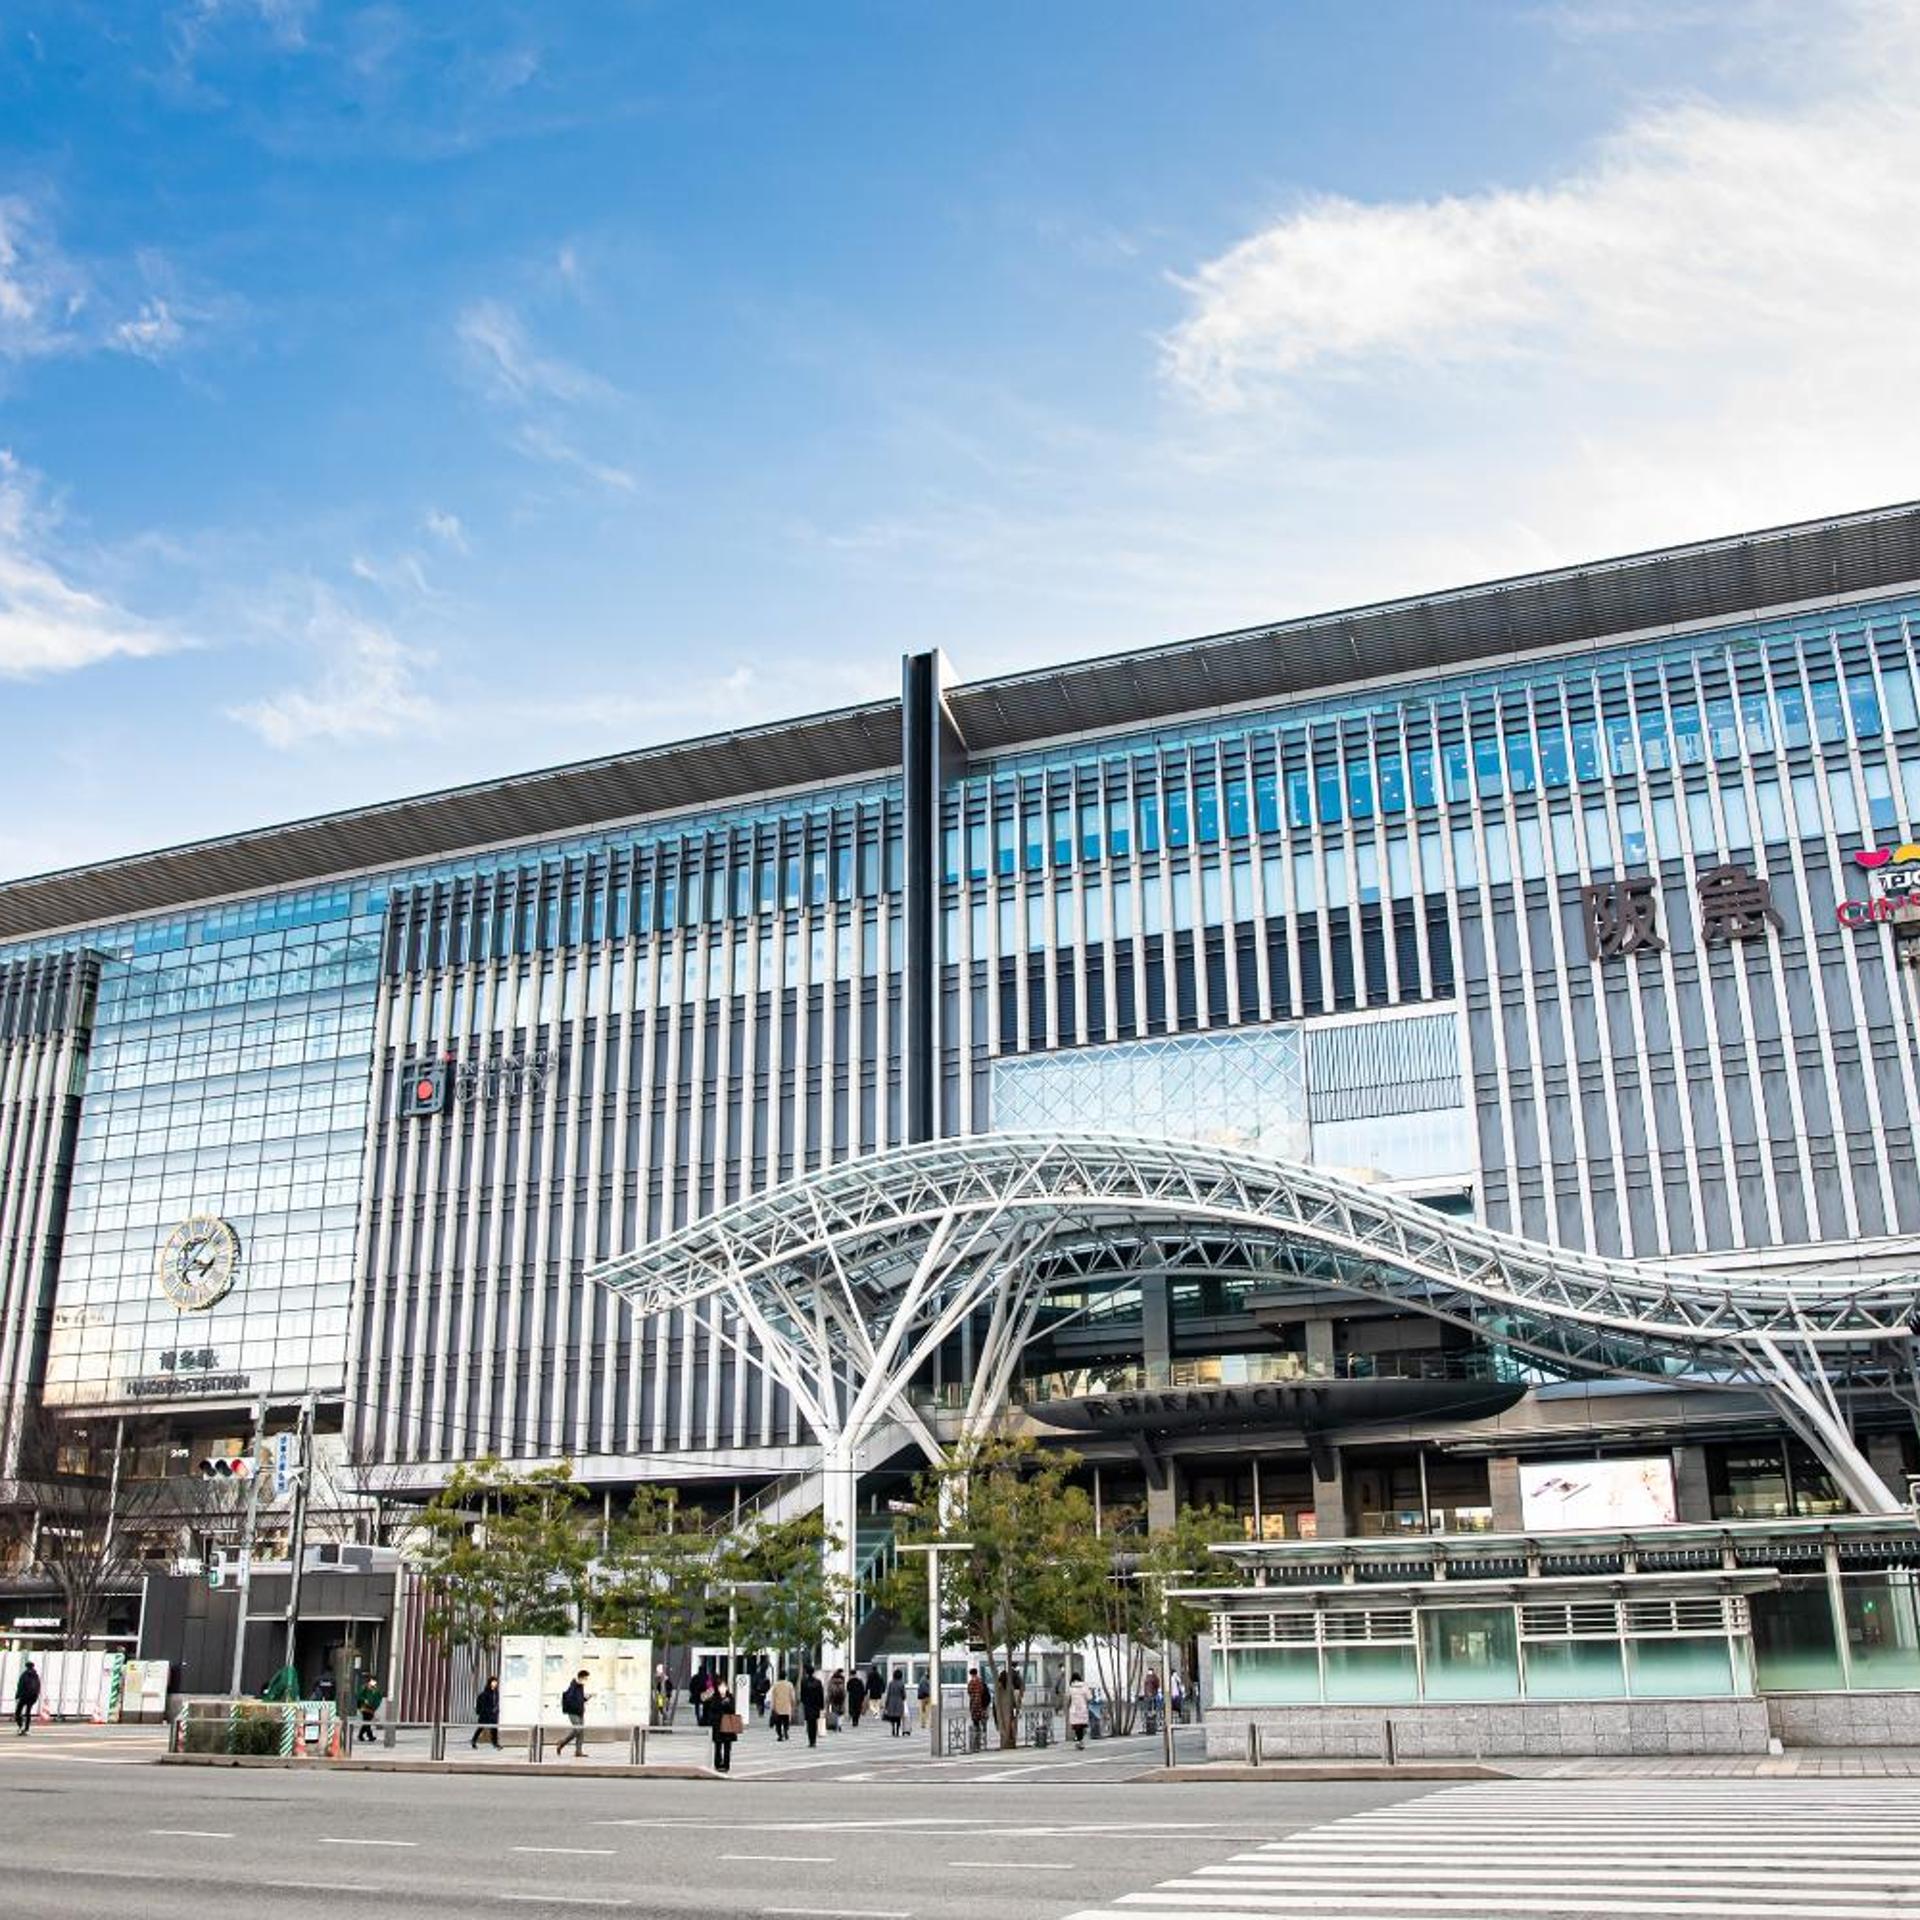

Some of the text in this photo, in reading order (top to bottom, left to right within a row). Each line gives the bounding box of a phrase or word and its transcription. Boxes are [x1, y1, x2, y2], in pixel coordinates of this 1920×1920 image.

[1580, 864, 1784, 961] 阪急
[1117, 1389, 1241, 1416] HAKATA
[1252, 1386, 1330, 1408] CITY
